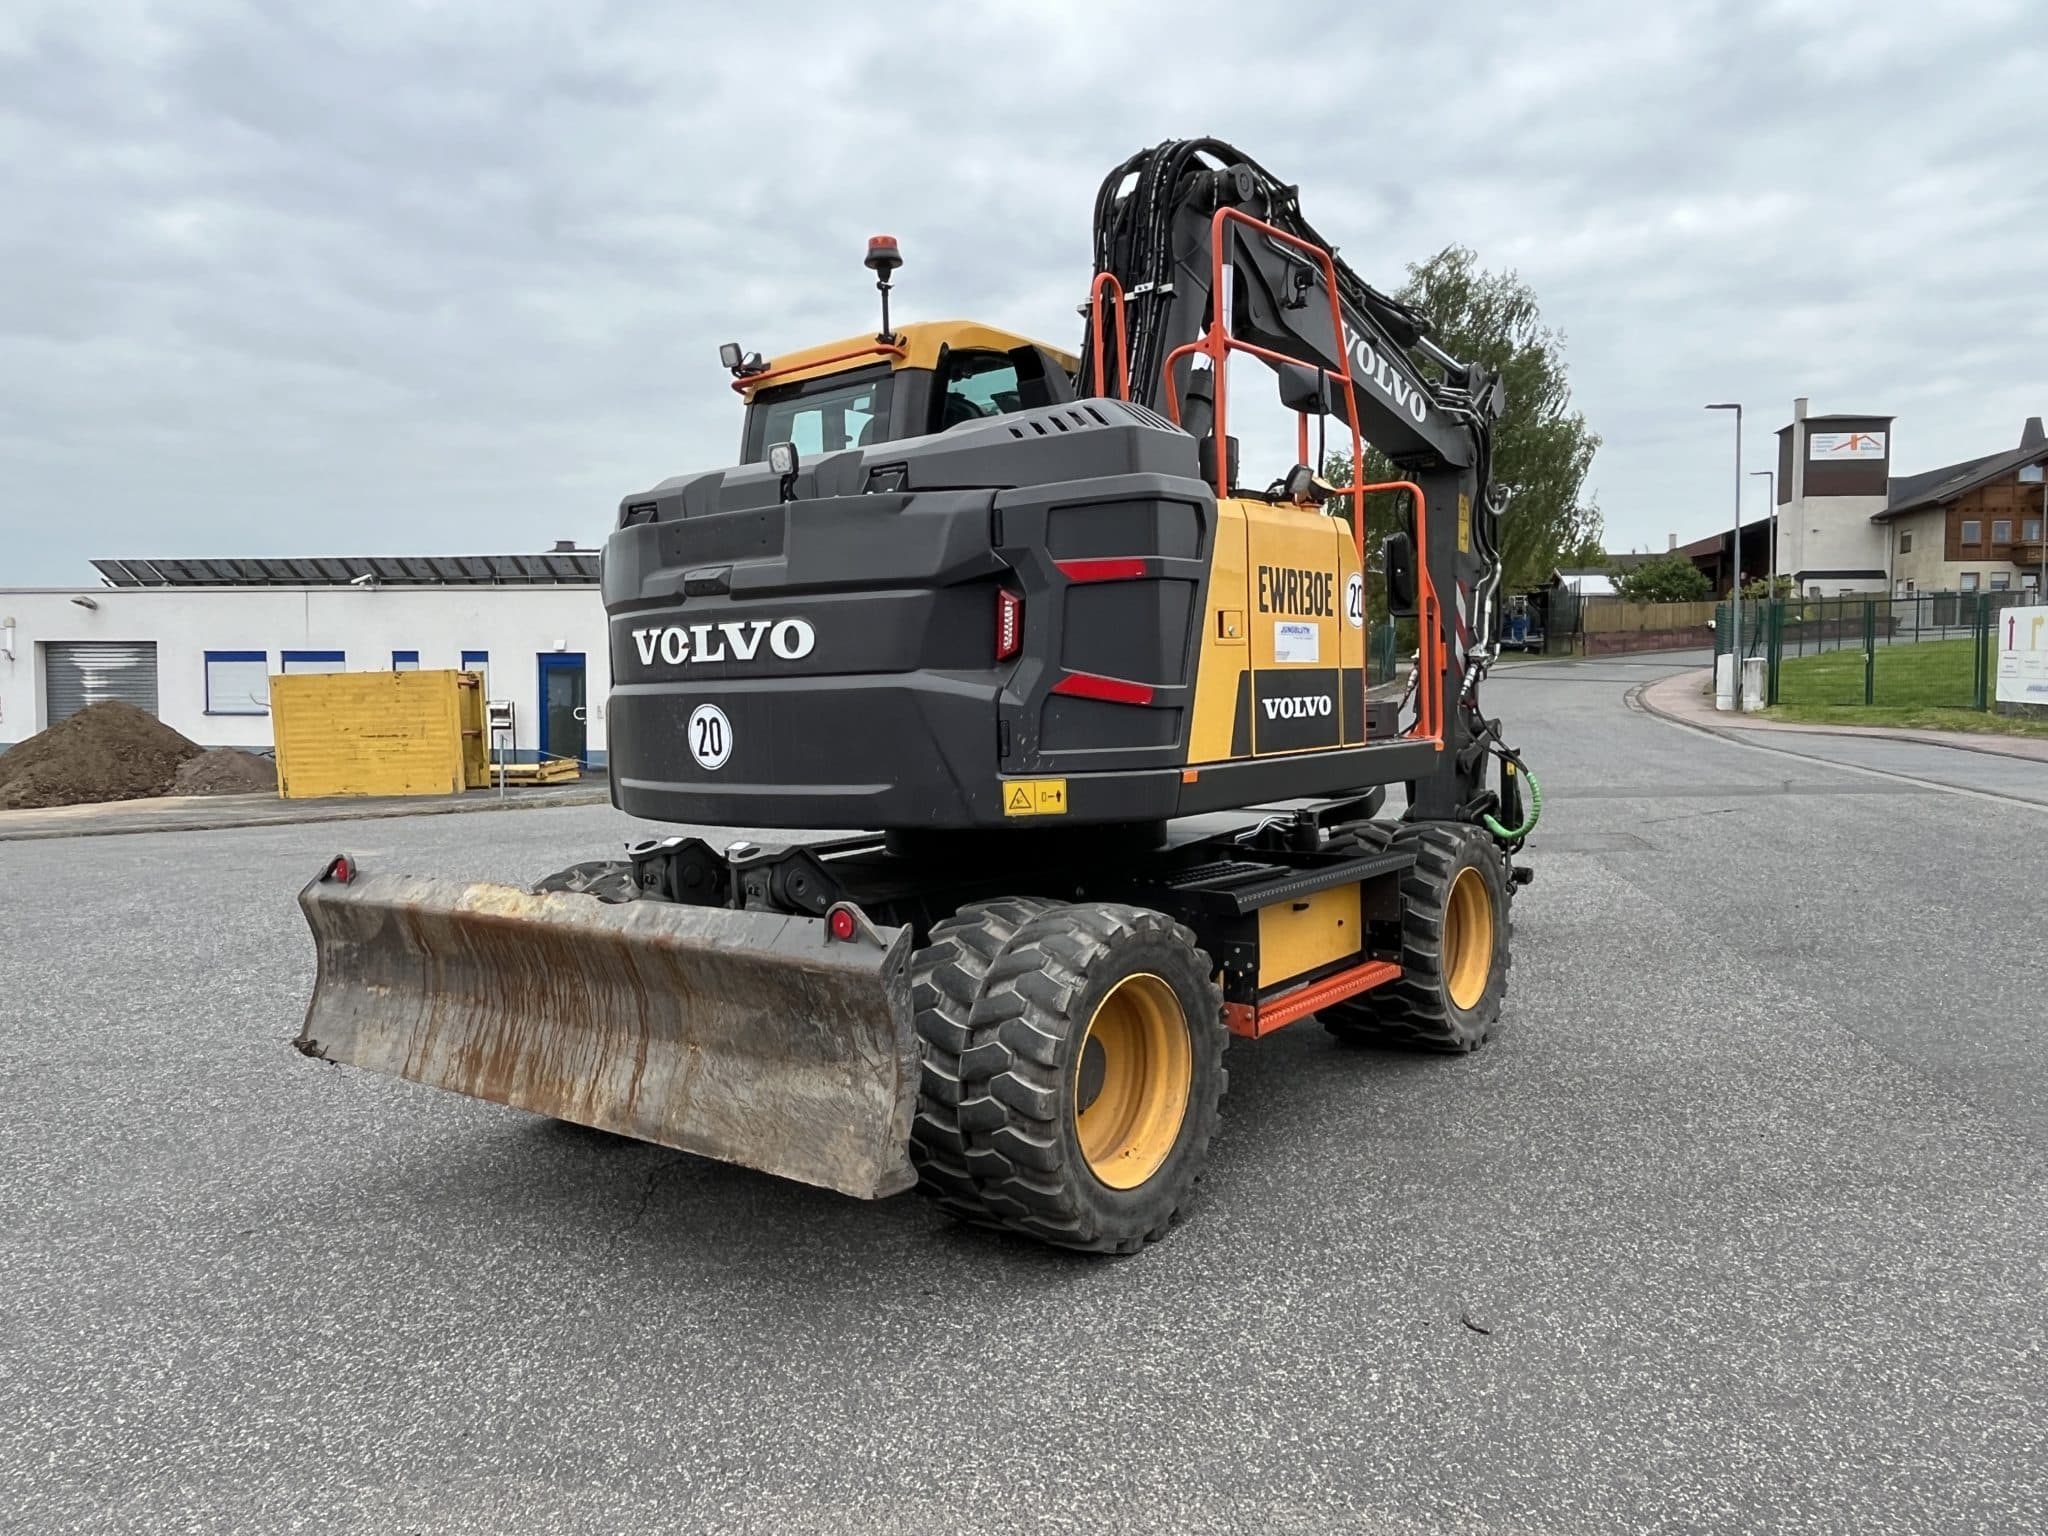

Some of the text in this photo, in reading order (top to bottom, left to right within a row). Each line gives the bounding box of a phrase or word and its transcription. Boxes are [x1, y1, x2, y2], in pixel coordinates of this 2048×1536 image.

[1340, 318, 1427, 423] VOLVO
[1258, 565, 1333, 617] EWR130E
[1350, 583, 1364, 618] 20
[632, 619, 816, 665] VOLVO
[1262, 695, 1332, 719] VOLVO
[696, 717, 723, 757] 20
